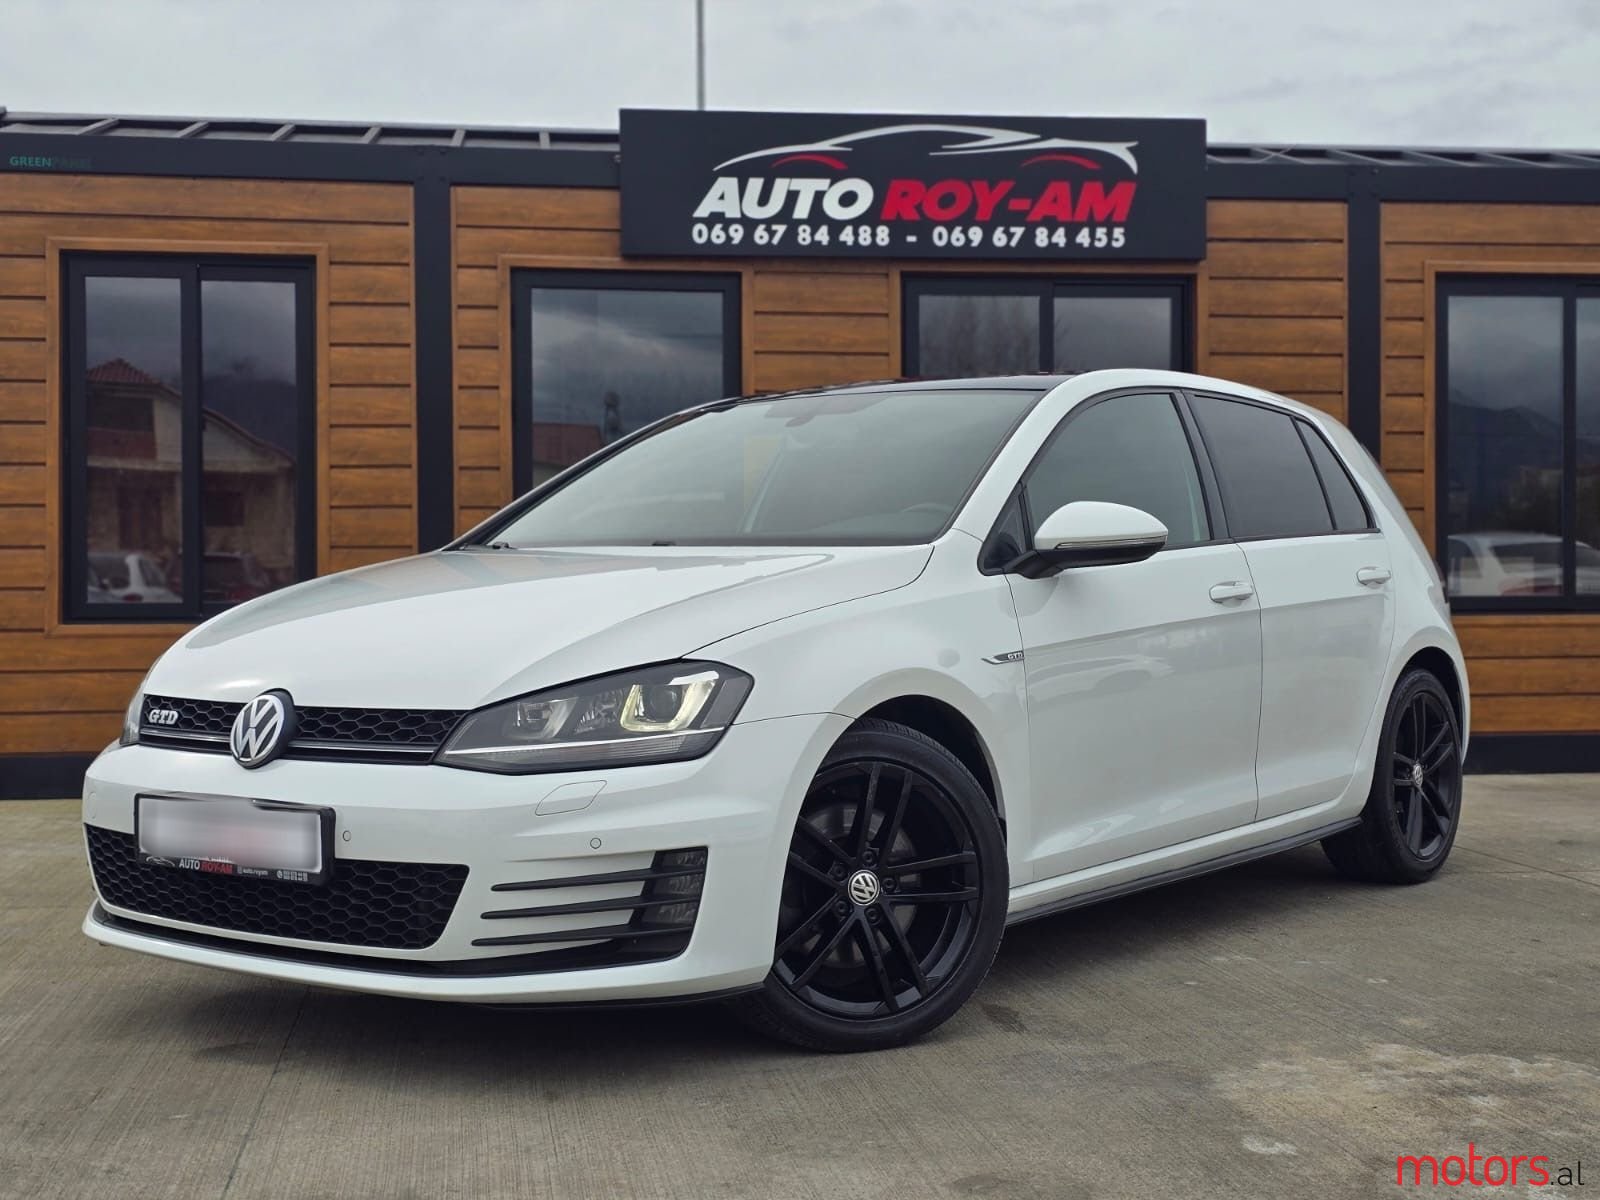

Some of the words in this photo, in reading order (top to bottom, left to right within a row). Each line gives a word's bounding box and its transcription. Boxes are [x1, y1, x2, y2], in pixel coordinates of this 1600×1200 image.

[692, 177, 874, 220] AUTO
[880, 180, 1136, 222] ROY-AM
[692, 223, 745, 245] 069
[753, 224, 788, 246] 67
[797, 225, 830, 246] 84
[838, 225, 890, 247] 488
[932, 226, 984, 247] 069
[992, 226, 1026, 247] 67
[1034, 227, 1067, 248] 84
[1075, 227, 1126, 248] 455
[149, 709, 178, 725] GTD
[179, 859, 200, 870] AUTO
